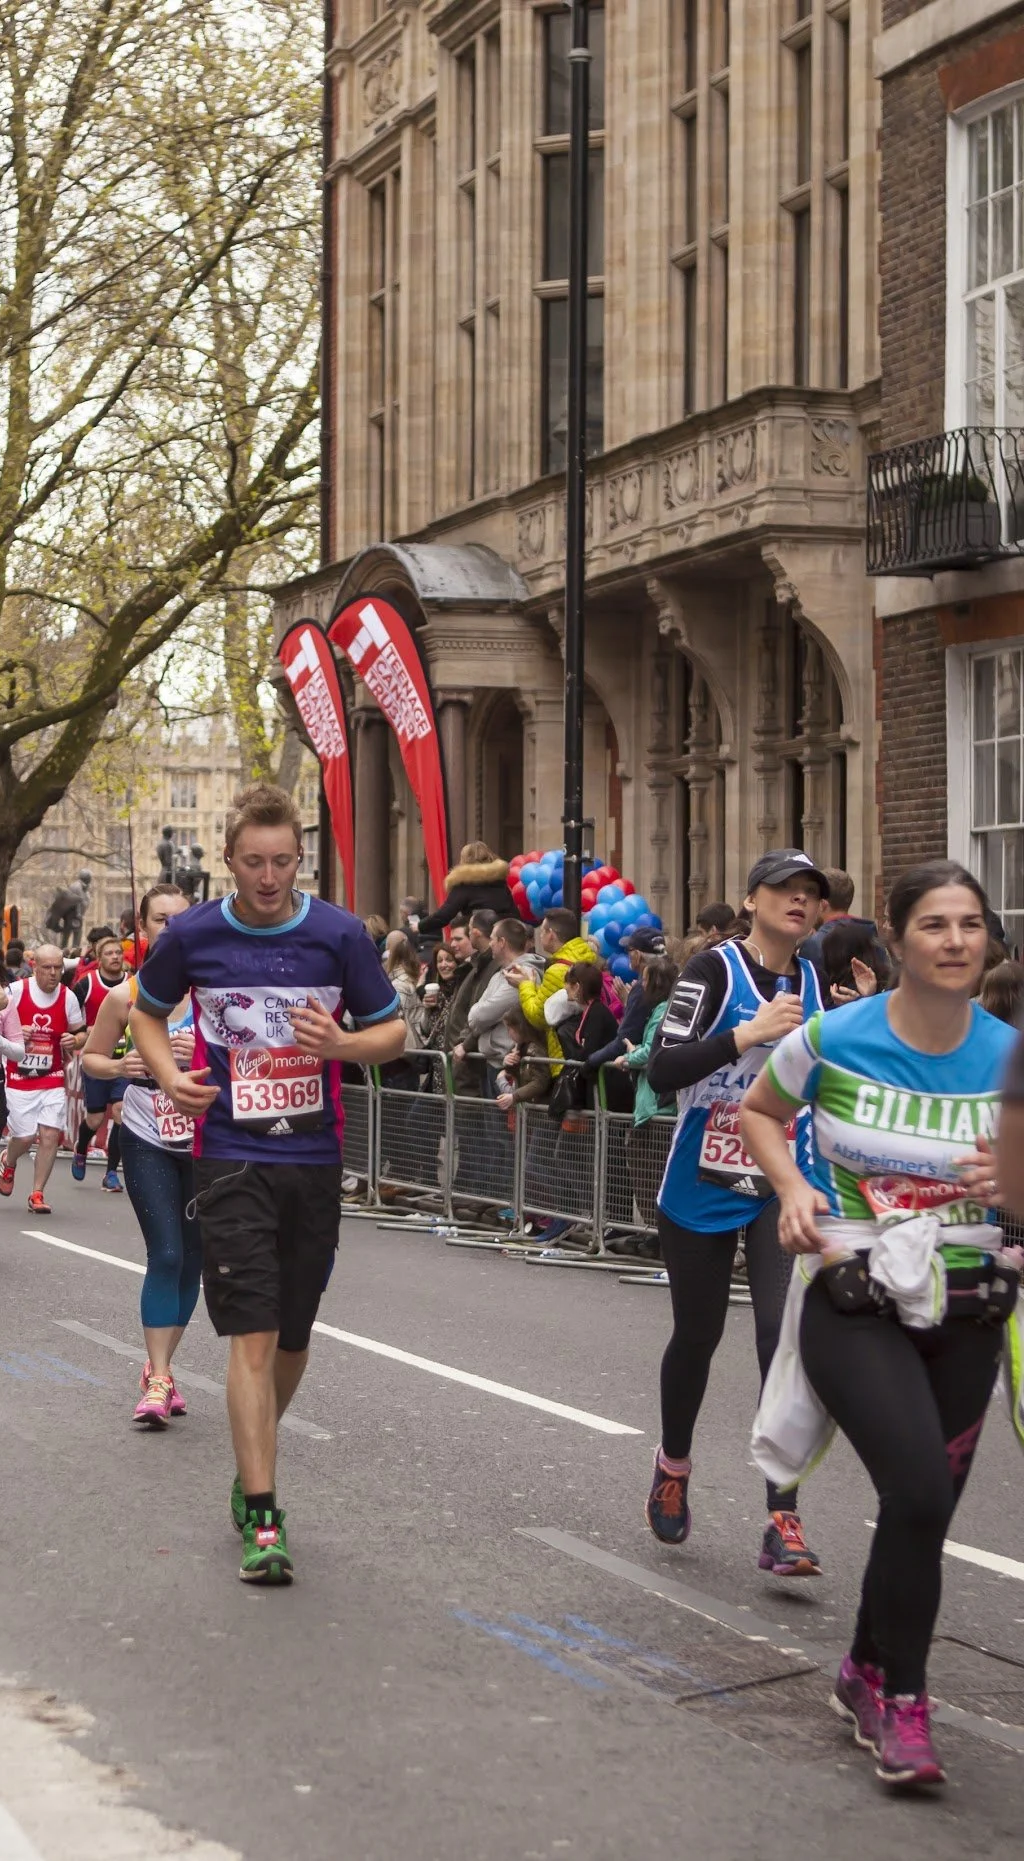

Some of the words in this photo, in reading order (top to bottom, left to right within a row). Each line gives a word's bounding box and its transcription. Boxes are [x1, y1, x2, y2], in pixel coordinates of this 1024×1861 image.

[367, 669, 404, 732] TRUST
[386, 645, 429, 734] TEENAGE
[299, 690, 324, 750] TRUST
[313, 669, 344, 751] TEENAGE
[264, 997, 319, 1009] CANC
[266, 1026, 284, 1038] UK
[22, 1054, 48, 1067] 2714
[237, 1049, 269, 1078] Virgin
[275, 1054, 319, 1068] money
[236, 1079, 320, 1112] 53969
[716, 1101, 741, 1132] Virgi
[853, 1084, 1003, 1142] GILLIAN
[832, 1142, 938, 1176] Alzheimer's
[729, 1186, 759, 1197] adidas
